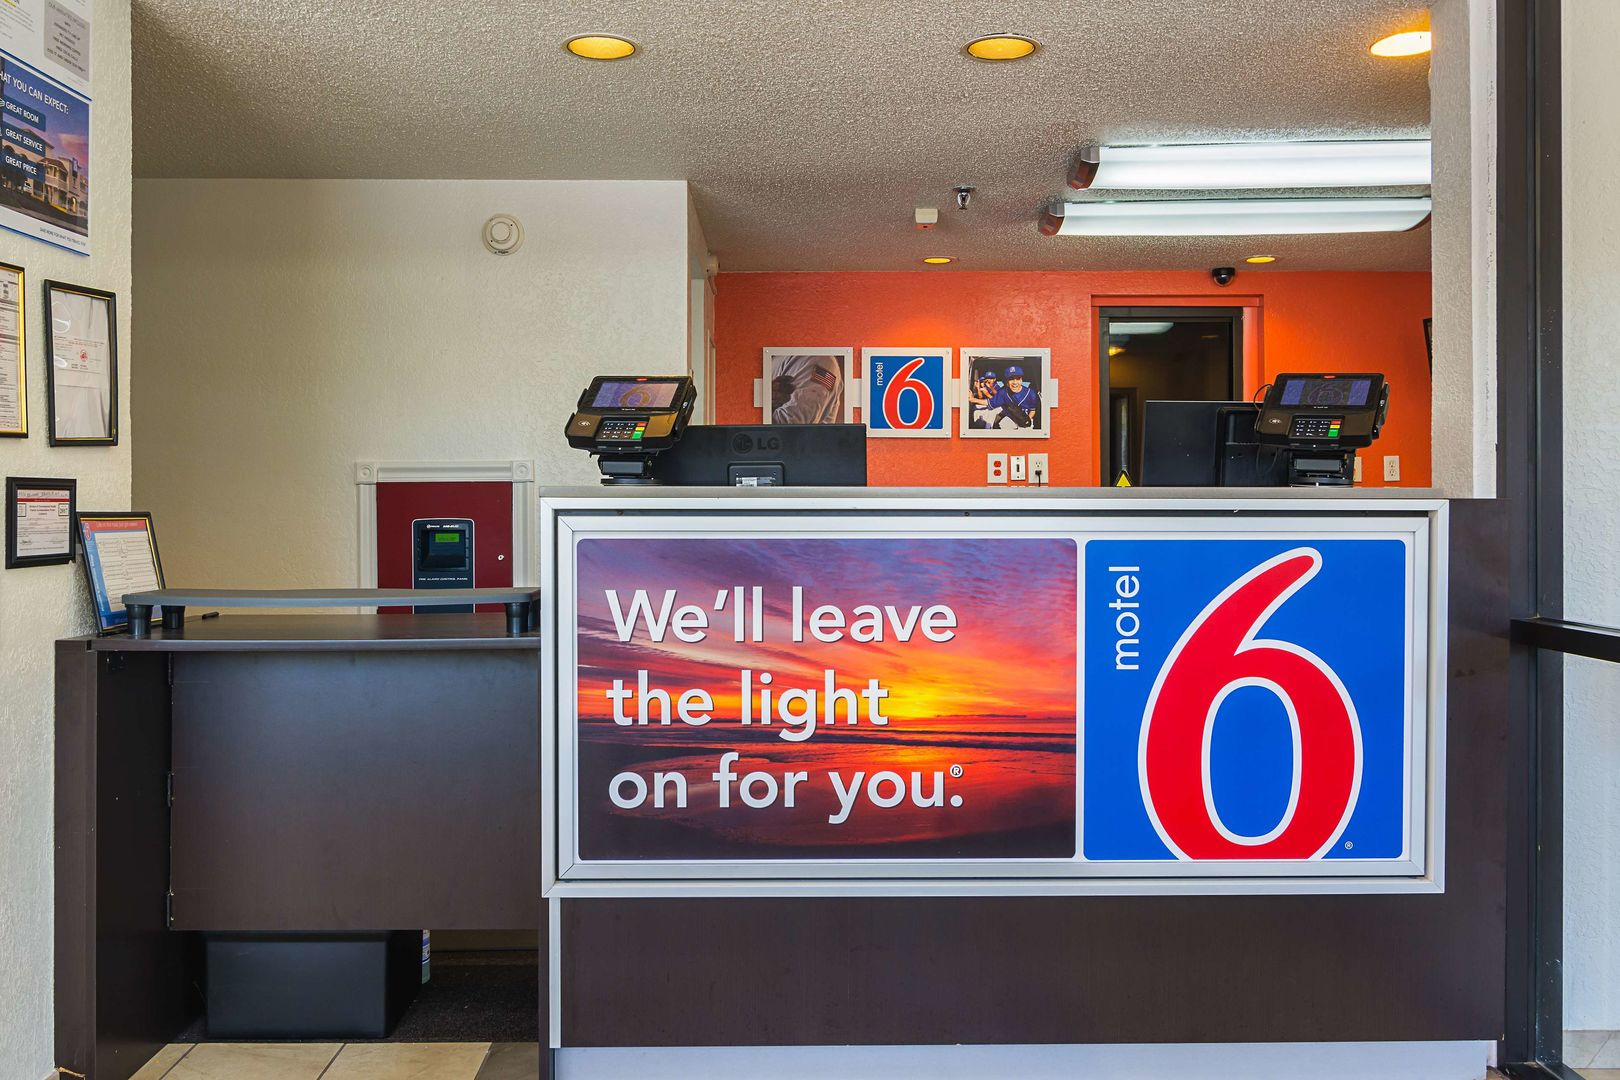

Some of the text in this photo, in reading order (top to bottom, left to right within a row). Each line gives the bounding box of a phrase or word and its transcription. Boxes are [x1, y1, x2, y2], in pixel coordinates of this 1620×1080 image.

[0, 71, 69, 114] HAT YOU CAN EXPECT:
[5, 101, 39, 123] GREAT ROOM
[5, 128, 43, 151] GREAT SERVICE
[5, 155, 37, 175] GREAT PRICE
[875, 357, 935, 429] motel 6
[757, 437, 779, 450] LG
[792, 586, 958, 644] leave
[606, 669, 889, 742] the light
[1108, 546, 1364, 861] motel 6
[608, 771, 688, 809] on
[712, 752, 808, 809] for
